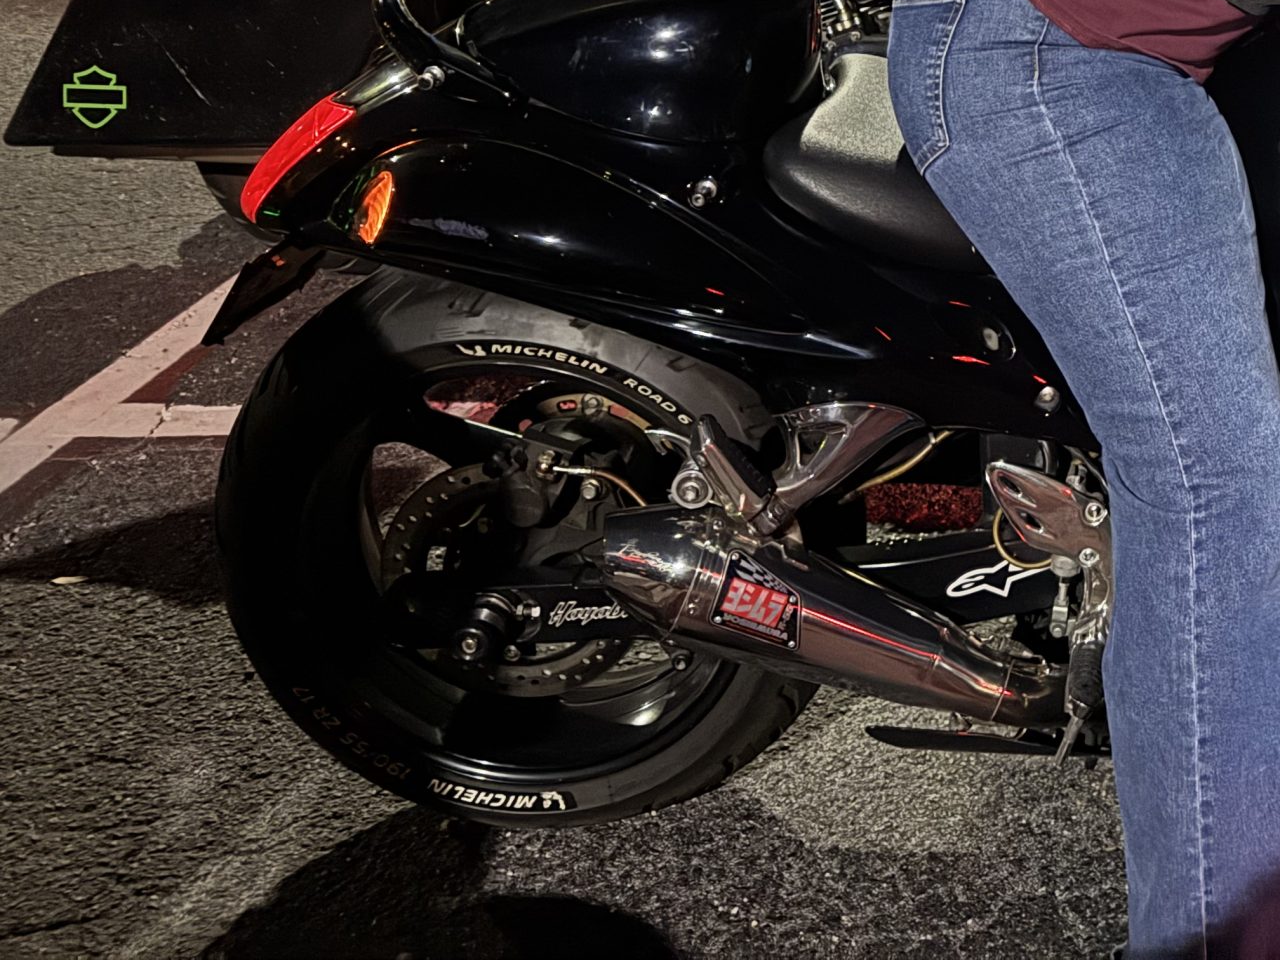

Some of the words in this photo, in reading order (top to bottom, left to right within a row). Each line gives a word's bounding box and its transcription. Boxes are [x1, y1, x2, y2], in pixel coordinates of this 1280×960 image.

[491, 343, 609, 375] MICHELIN
[623, 377, 677, 412] ROAD
[677, 413, 694, 426] 6
[427, 778, 538, 810] MICHELIN
